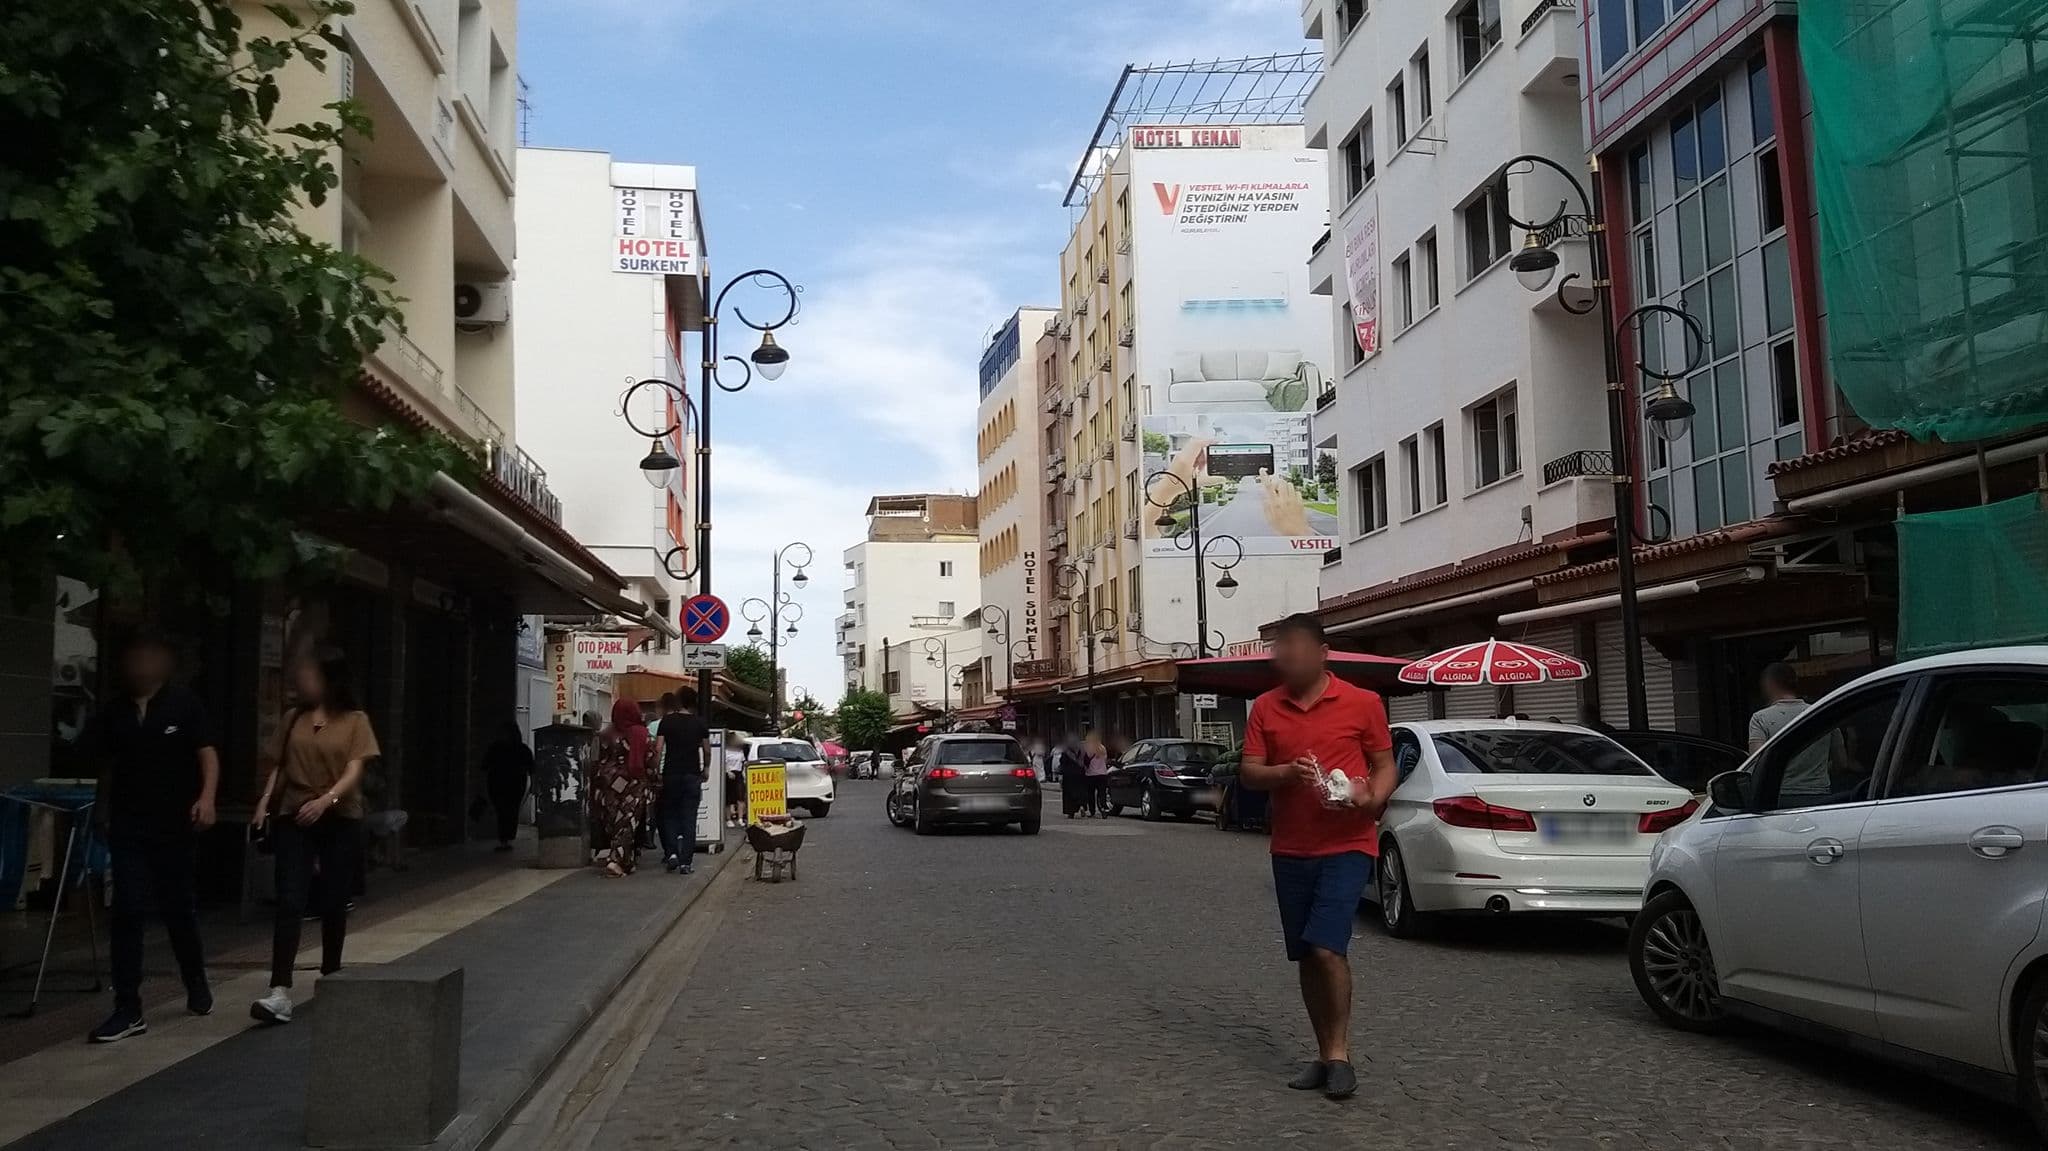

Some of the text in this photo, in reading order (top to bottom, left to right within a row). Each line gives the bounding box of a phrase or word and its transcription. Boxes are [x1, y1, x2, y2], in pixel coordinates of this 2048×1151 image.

[1135, 130, 1239, 147] HOTEL KENAN
[1189, 184, 1223, 192] VESTEL
[1238, 191, 1294, 202] HAVASINI
[622, 190, 636, 236] HOTEL
[1253, 203, 1300, 212] YERDEN
[669, 192, 684, 238] HOTEL
[619, 239, 691, 258] HOTEL
[620, 258, 689, 273] SURKENT
[1290, 539, 1335, 549] VESTEL
[1024, 551, 1036, 594] HOTEL
[577, 640, 623, 654] OTO PARK
[586, 659, 614, 669] YIKAMA
[555, 644, 567, 710] OTOPARK
[1442, 673, 1474, 681] ALGIDA
[1499, 672, 1533, 681] ALGIDA
[750, 789, 785, 802] OTOPARK
